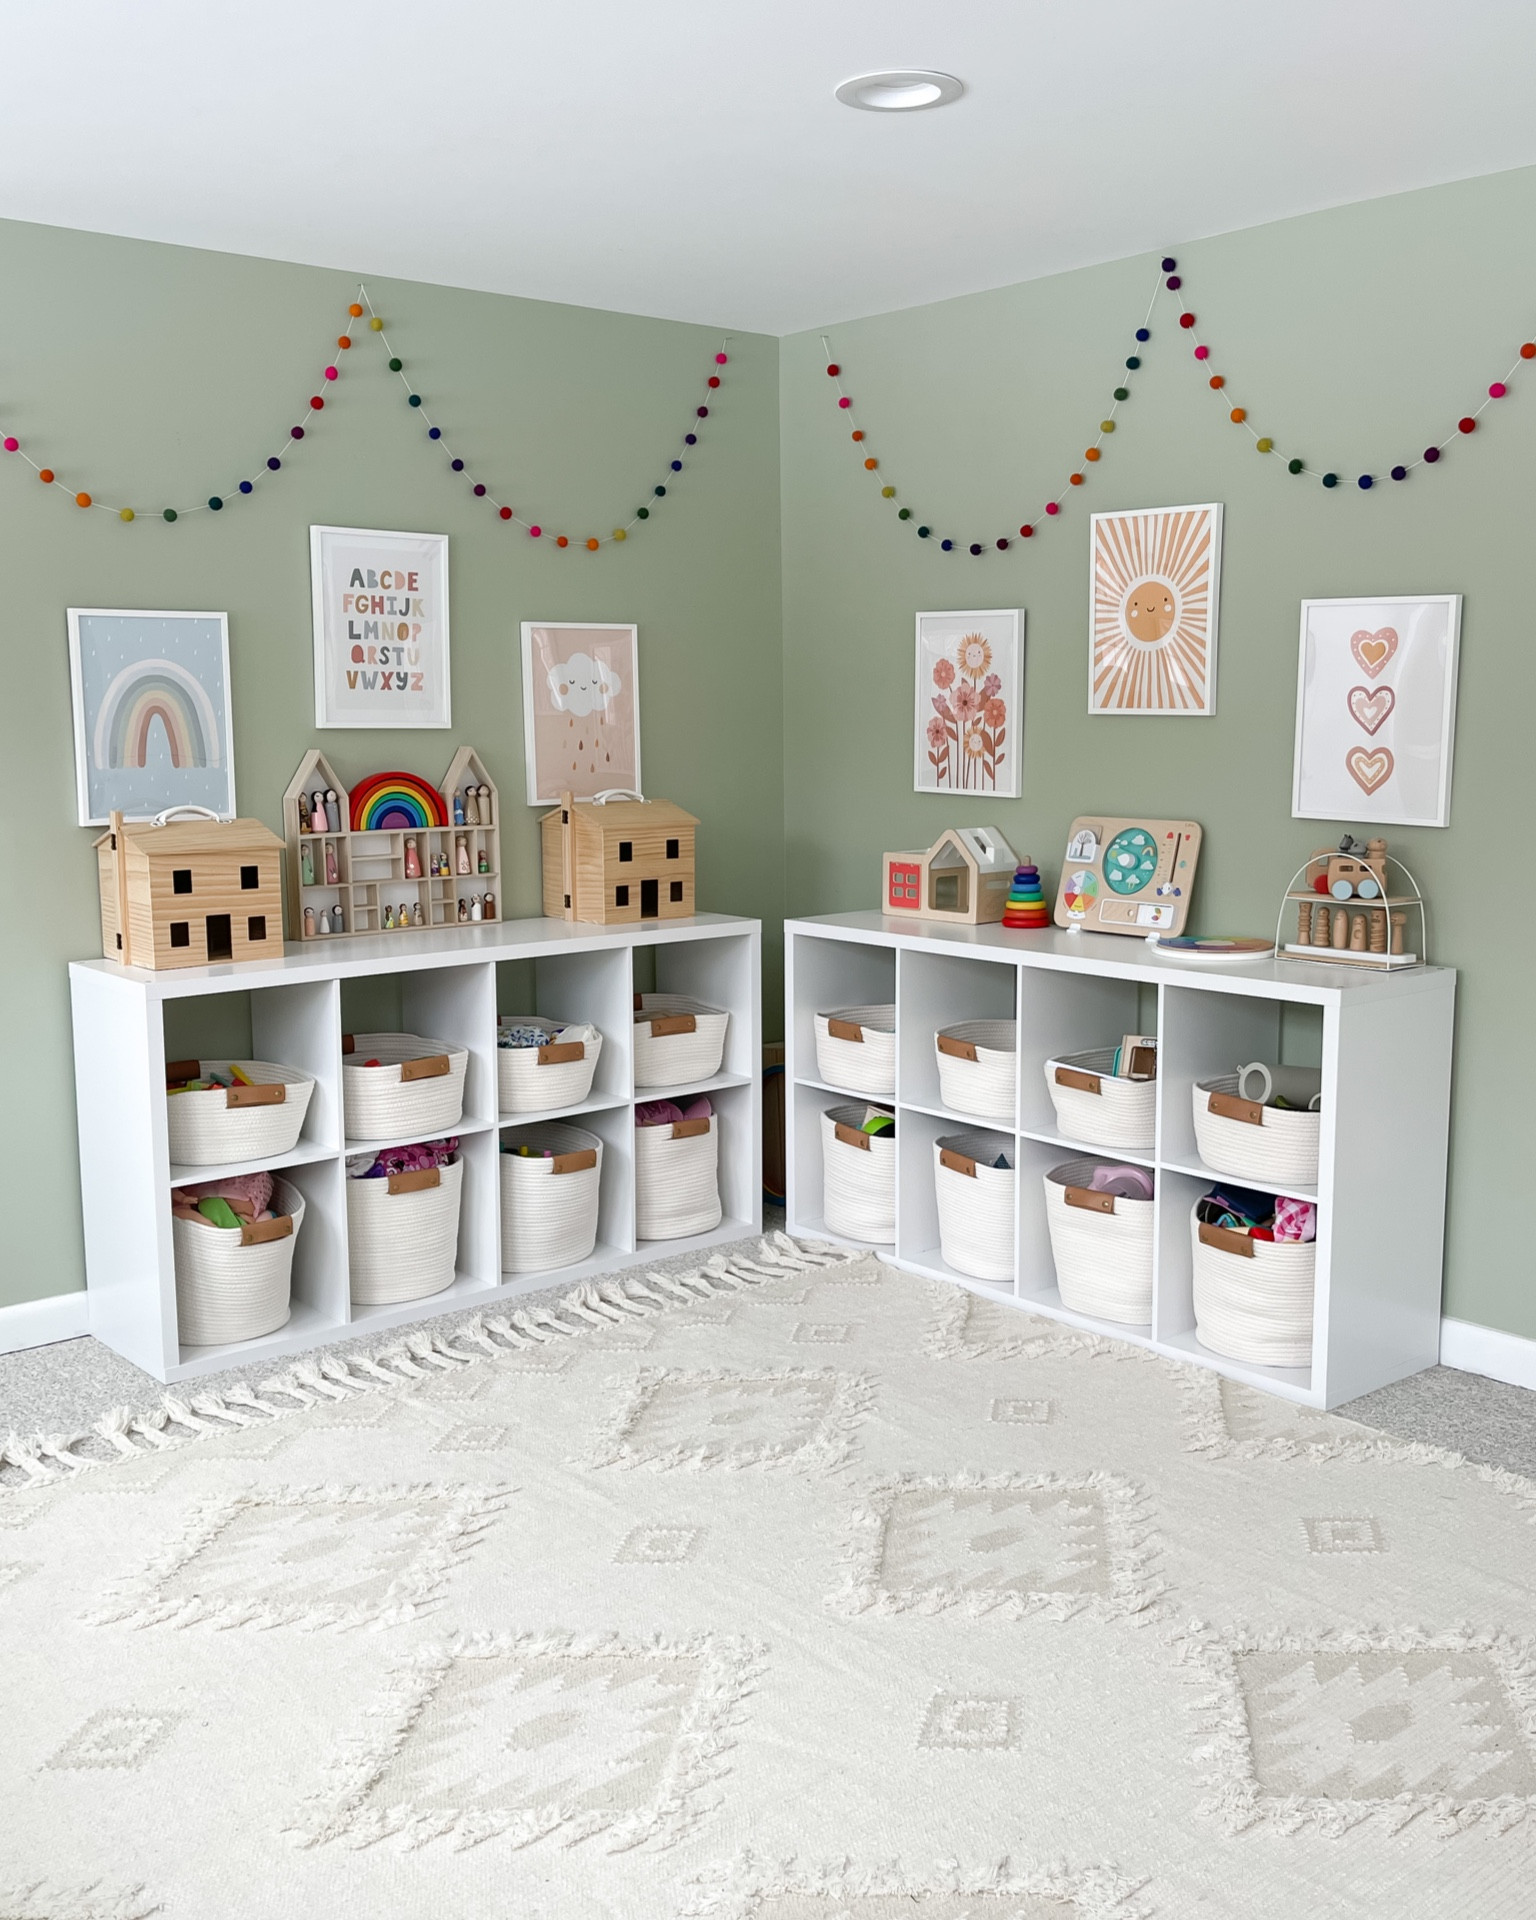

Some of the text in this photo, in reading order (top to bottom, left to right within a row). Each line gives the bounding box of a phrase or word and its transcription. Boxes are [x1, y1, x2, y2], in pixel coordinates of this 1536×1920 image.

[349, 568, 419, 592] ABCDE
[343, 593, 425, 618] FGHIJK
[348, 620, 422, 643] LMNOP
[350, 644, 420, 667] QRSTU
